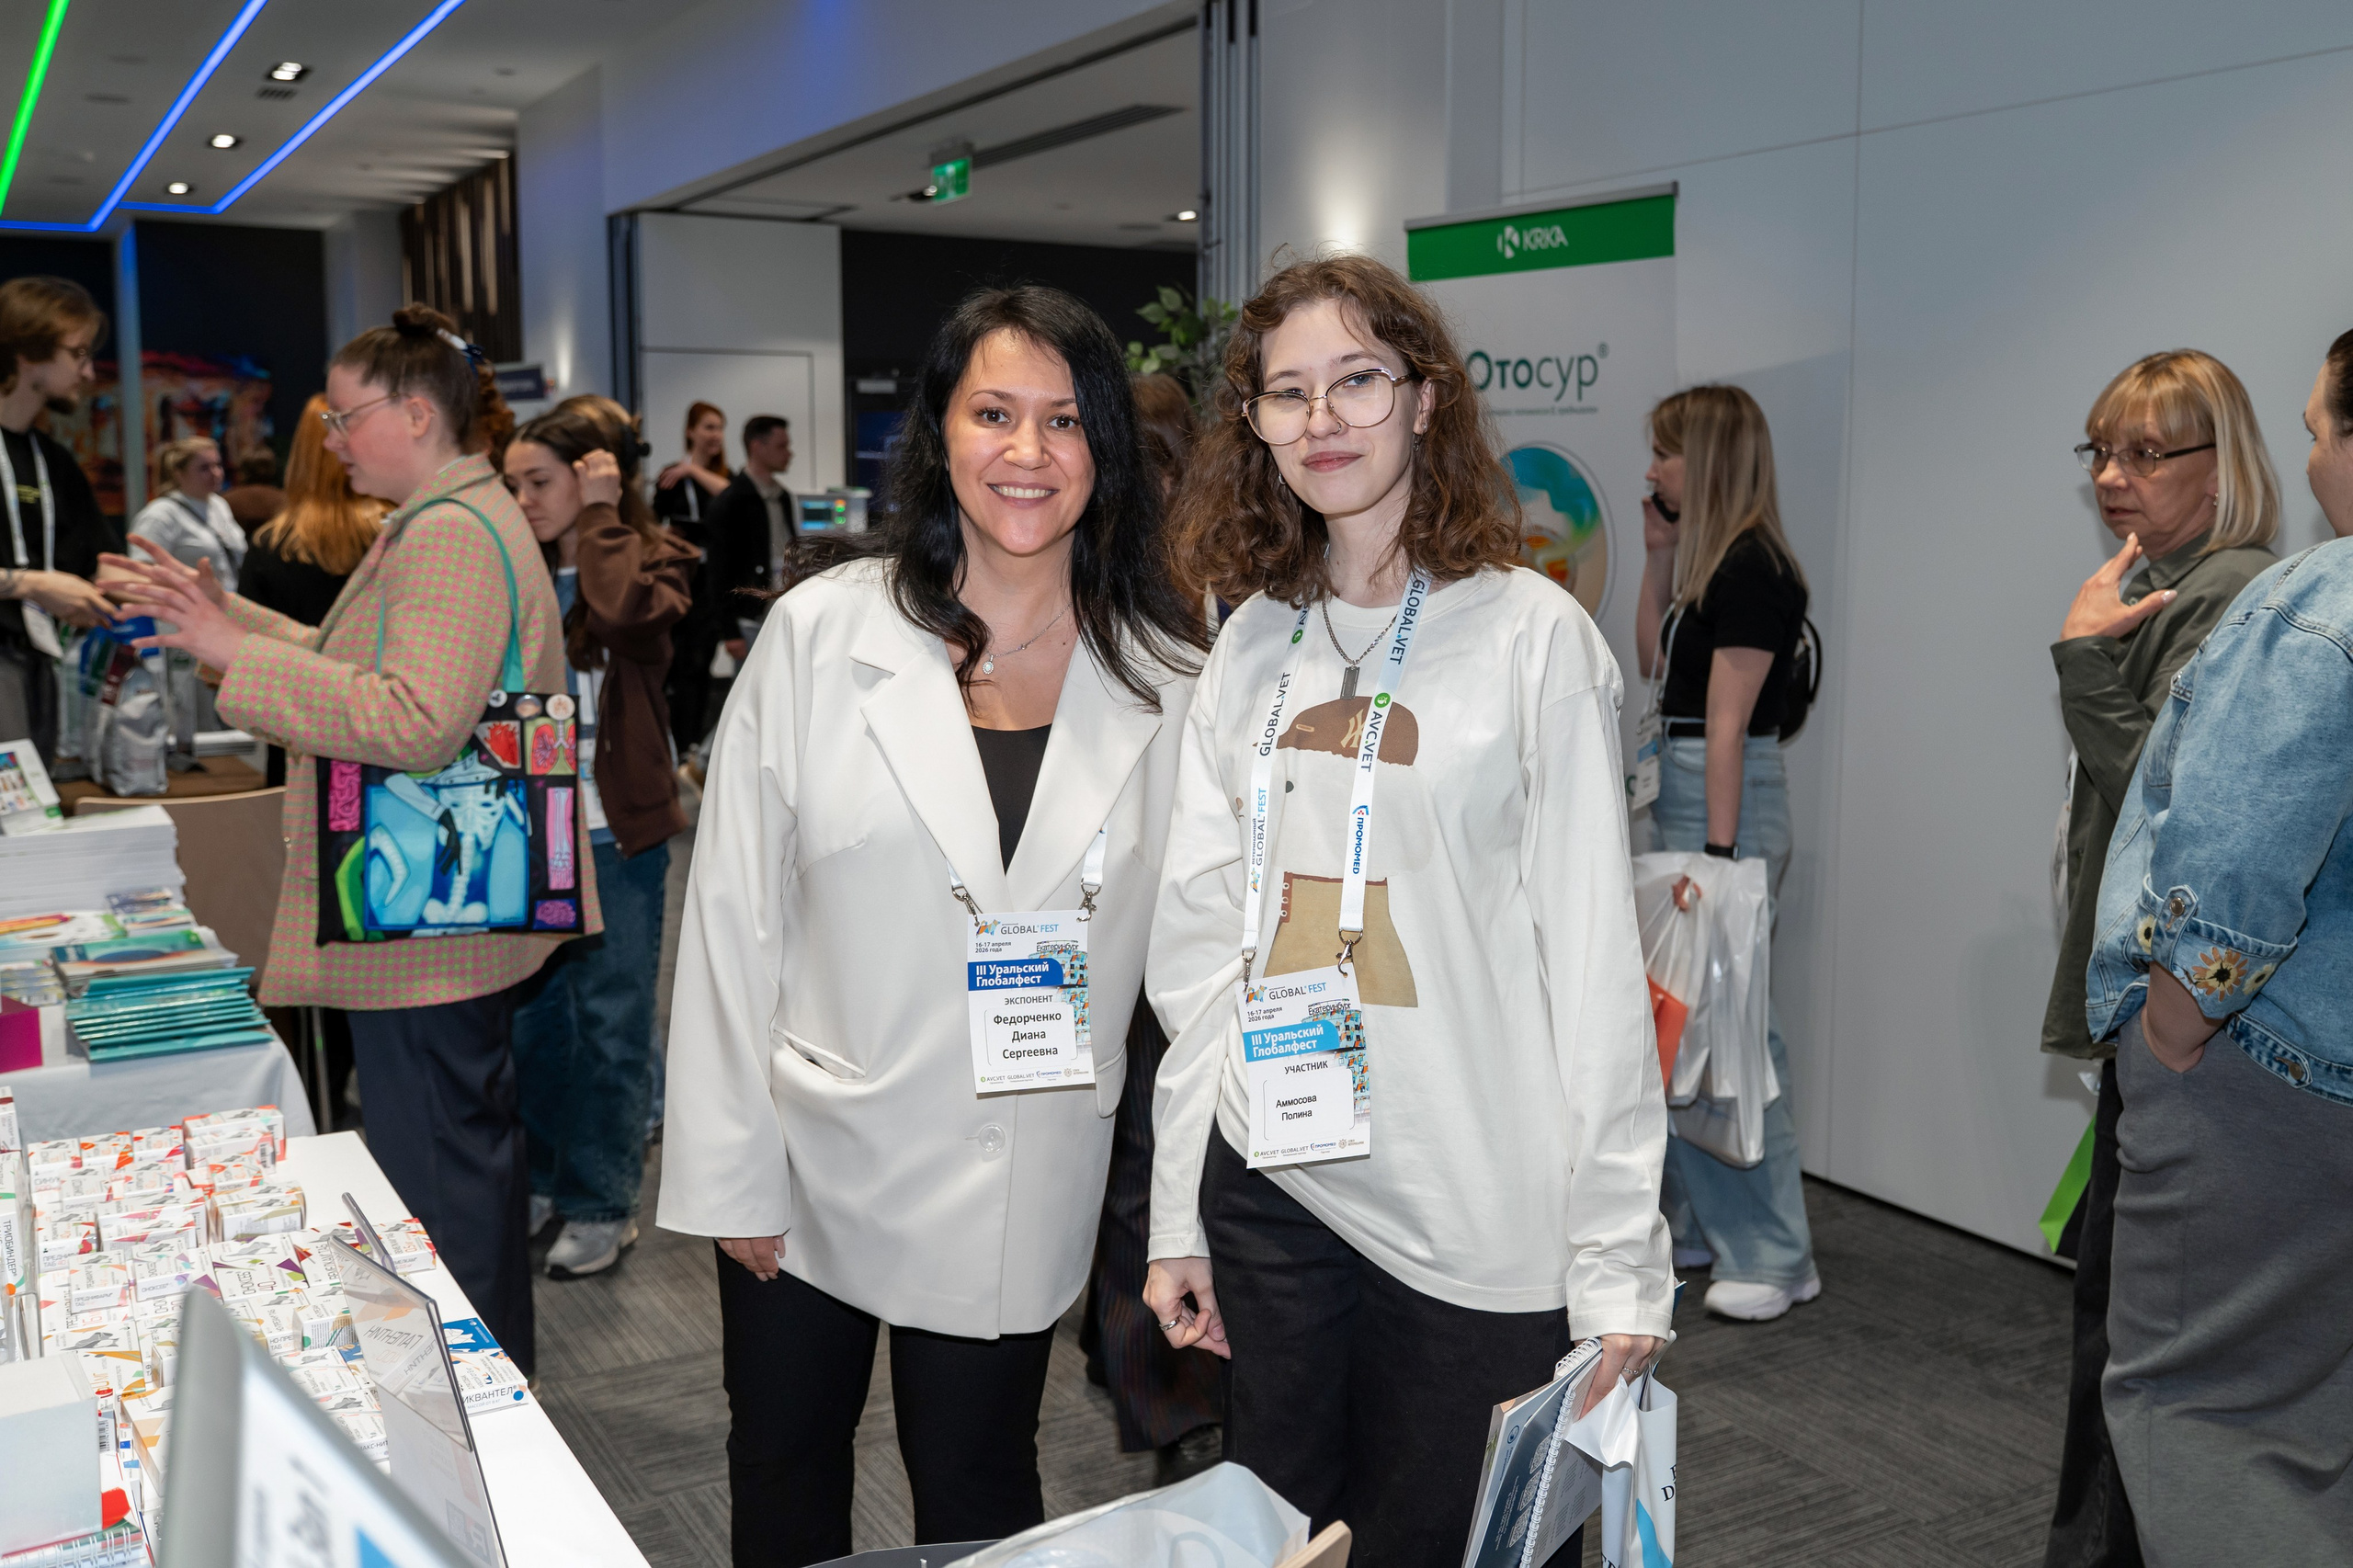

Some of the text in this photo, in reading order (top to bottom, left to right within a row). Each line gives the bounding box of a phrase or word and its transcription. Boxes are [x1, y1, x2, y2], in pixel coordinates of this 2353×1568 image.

[1522, 224, 1569, 251] KRKA
[1258, 672, 1291, 756] GLOBAL.VET
[1360, 710, 1383, 772] AVC.VET
[1257, 788, 1267, 812] FEST
[1040, 924, 1060, 933] FEST
[1036, 942, 1079, 952] Екатеринбург
[989, 961, 1050, 976] Уральский
[976, 974, 1041, 987] Глобалфест
[1308, 983, 1326, 994] FEST
[1004, 994, 1053, 1006] ЭКСПОНЕНТ
[1263, 1006, 1282, 1015] апреля
[1308, 1002, 1351, 1016] Екатеринбург
[994, 1011, 1062, 1027] Федорченко
[1012, 1029, 1047, 1043] Диана
[1265, 1024, 1324, 1043] Уральский
[1003, 1047, 1058, 1061] Сергеевна
[1253, 1040, 1317, 1058] Глобалфест
[1284, 1061, 1328, 1074] УЧАСТНИК
[1276, 1095, 1317, 1108] Аммосова
[1281, 1109, 1313, 1121] Полина
